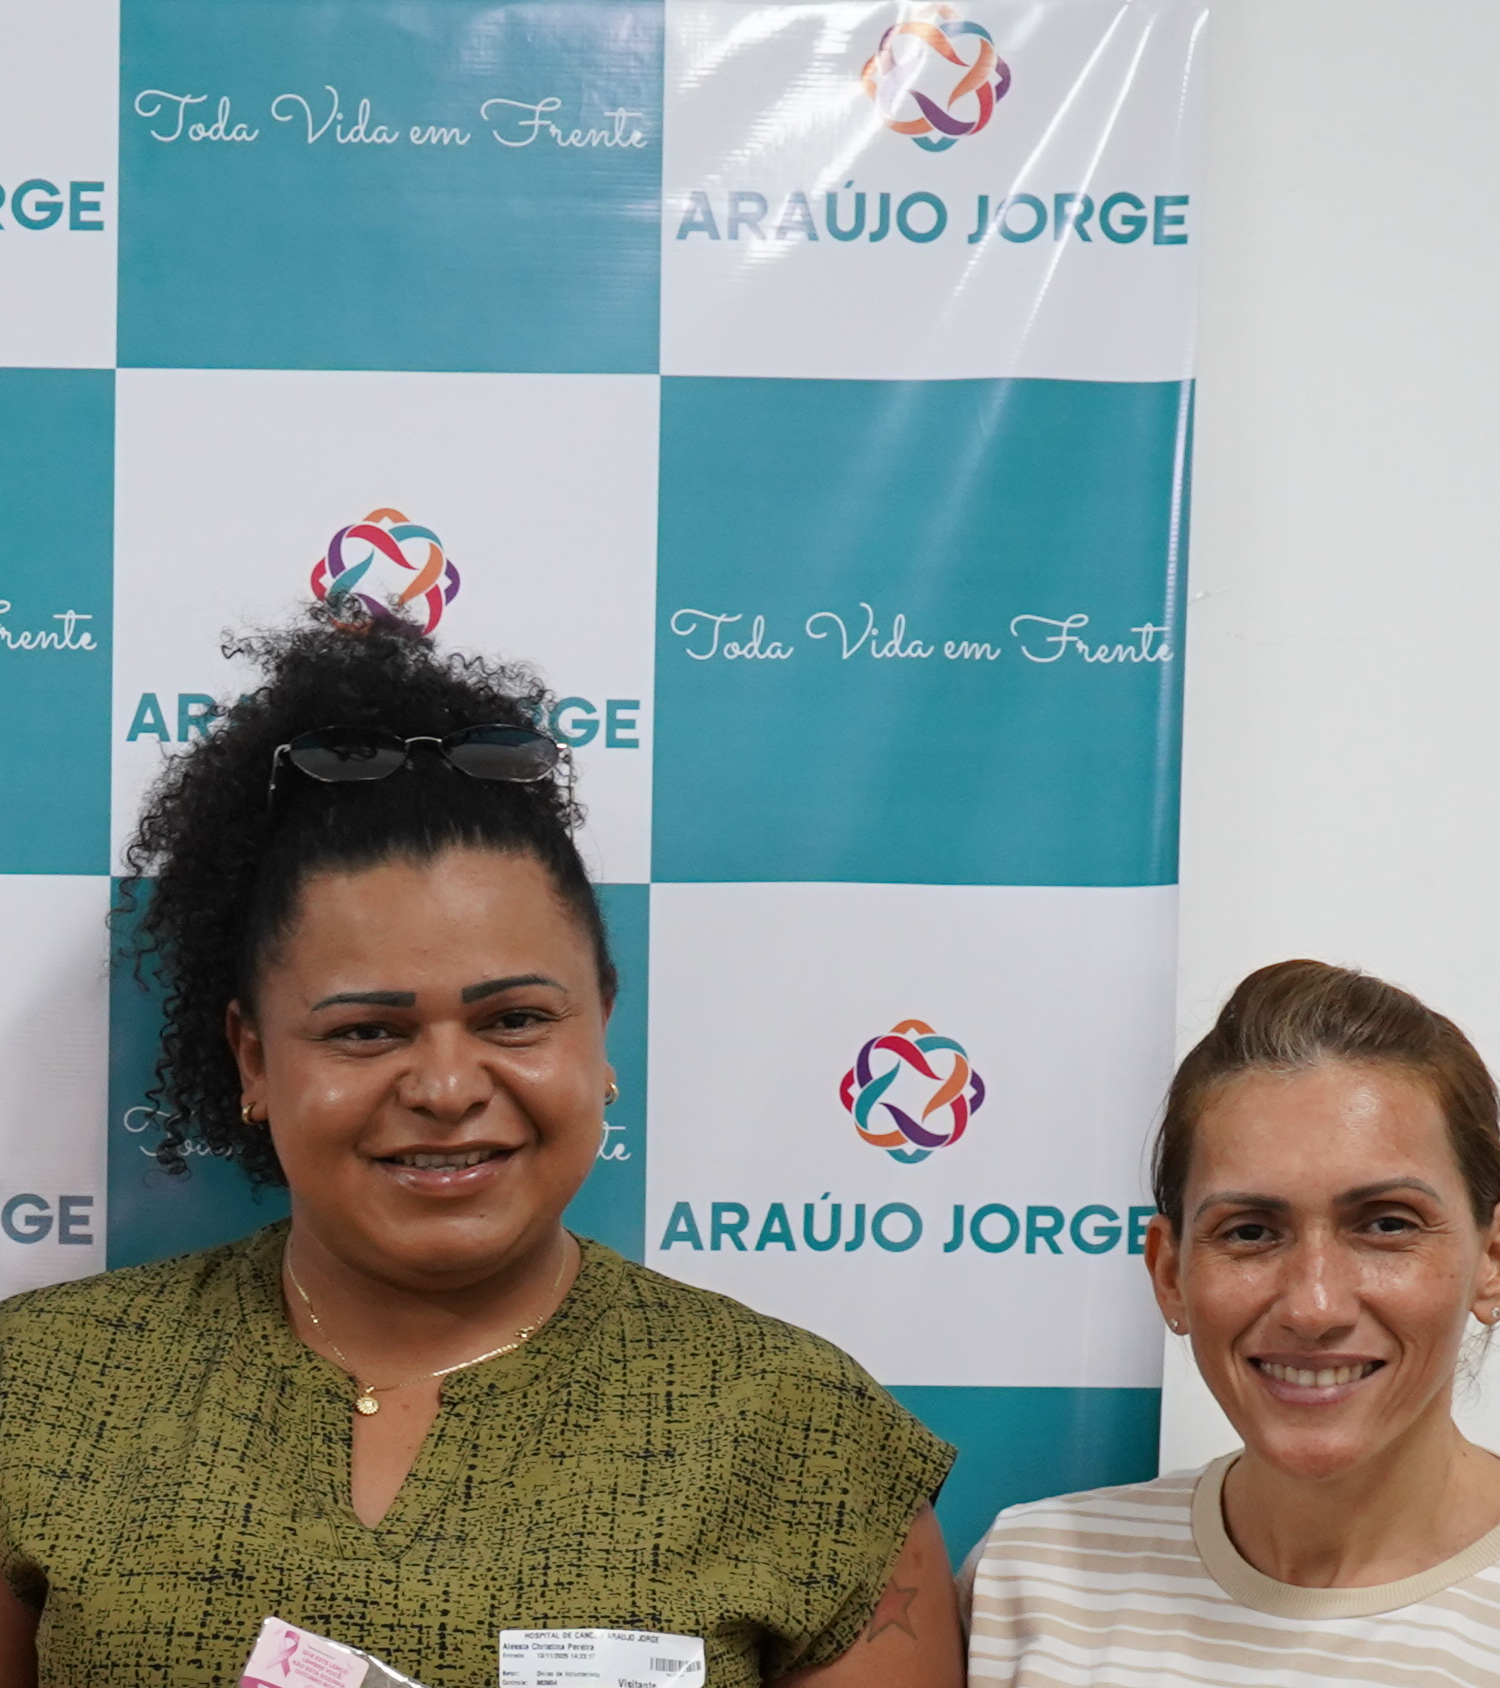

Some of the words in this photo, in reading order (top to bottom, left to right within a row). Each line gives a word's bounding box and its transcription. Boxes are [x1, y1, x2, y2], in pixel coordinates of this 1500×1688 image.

[135, 90, 258, 142] Toda
[272, 86, 399, 144] Vida
[410, 126, 470, 145] em
[481, 93, 649, 148] Frente
[677, 182, 947, 243] ARAÚJO
[968, 193, 1189, 245] JORGE
[671, 609, 794, 660] Toda
[806, 603, 934, 659] Vida
[944, 641, 1000, 660] em
[1011, 613, 1174, 663] Frente
[662, 1193, 921, 1252] ARAÚJO
[943, 1203, 1158, 1255] JORGE
